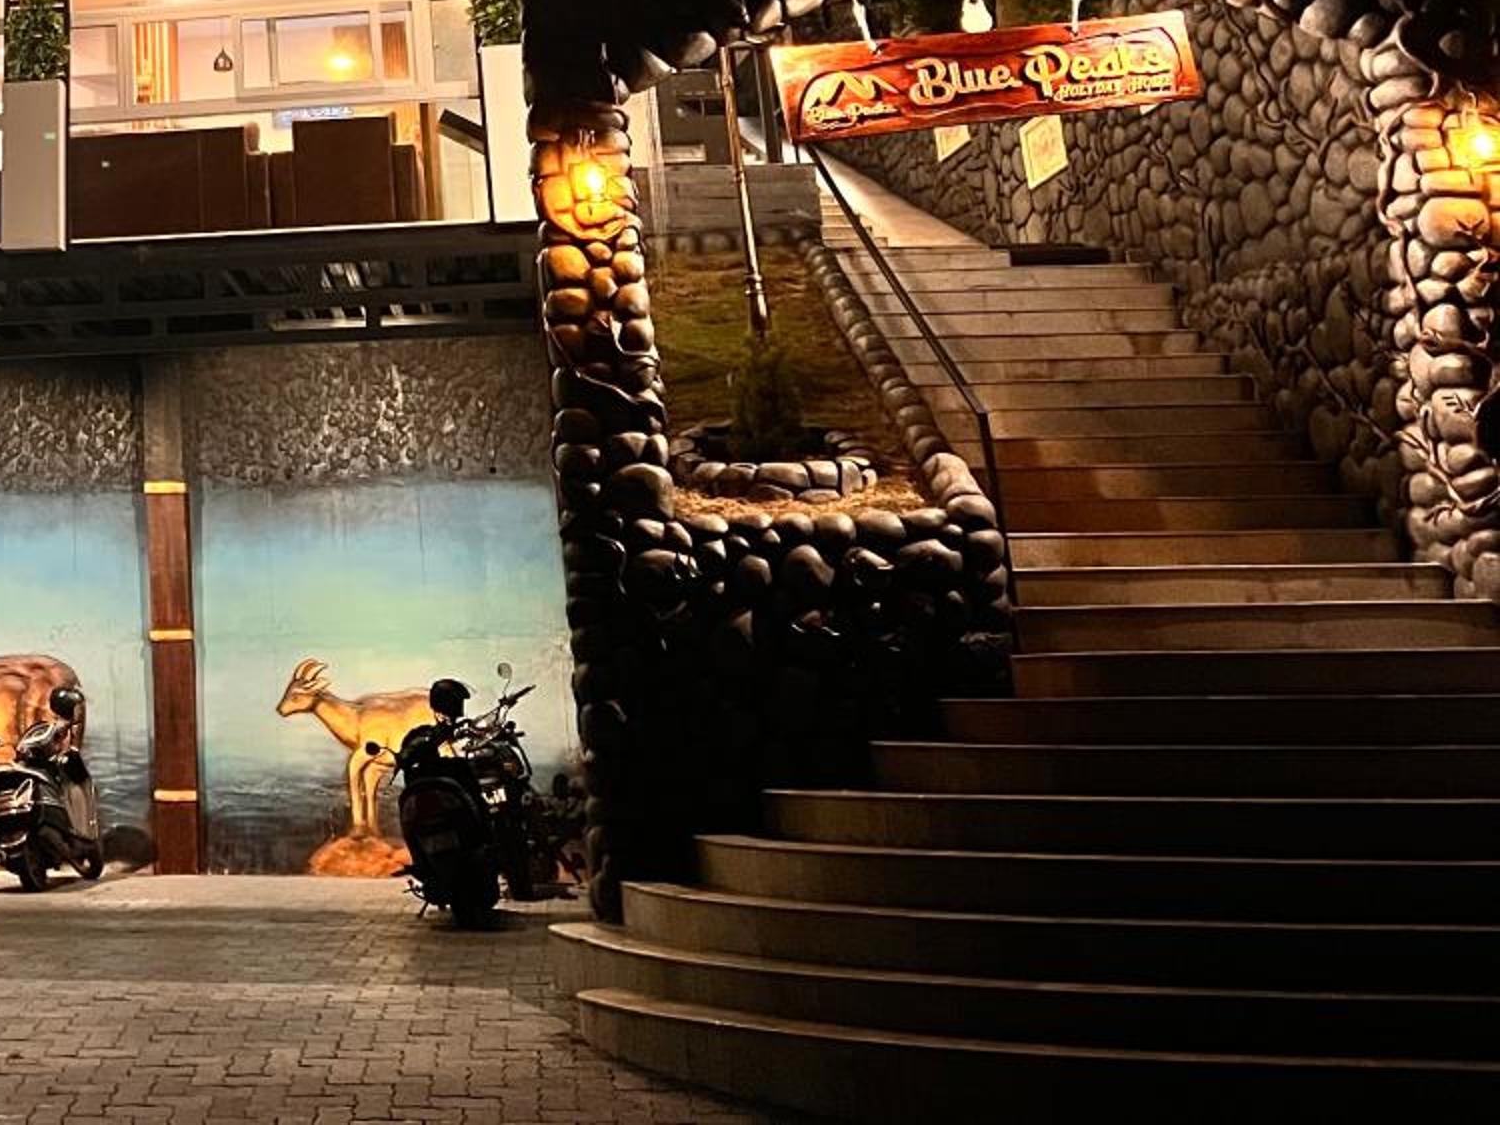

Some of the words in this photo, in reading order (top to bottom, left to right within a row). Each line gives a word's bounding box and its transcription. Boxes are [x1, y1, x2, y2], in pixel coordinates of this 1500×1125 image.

[905, 57, 1022, 106] Blue
[1021, 44, 1172, 97] Peaks
[805, 105, 847, 126] Blue
